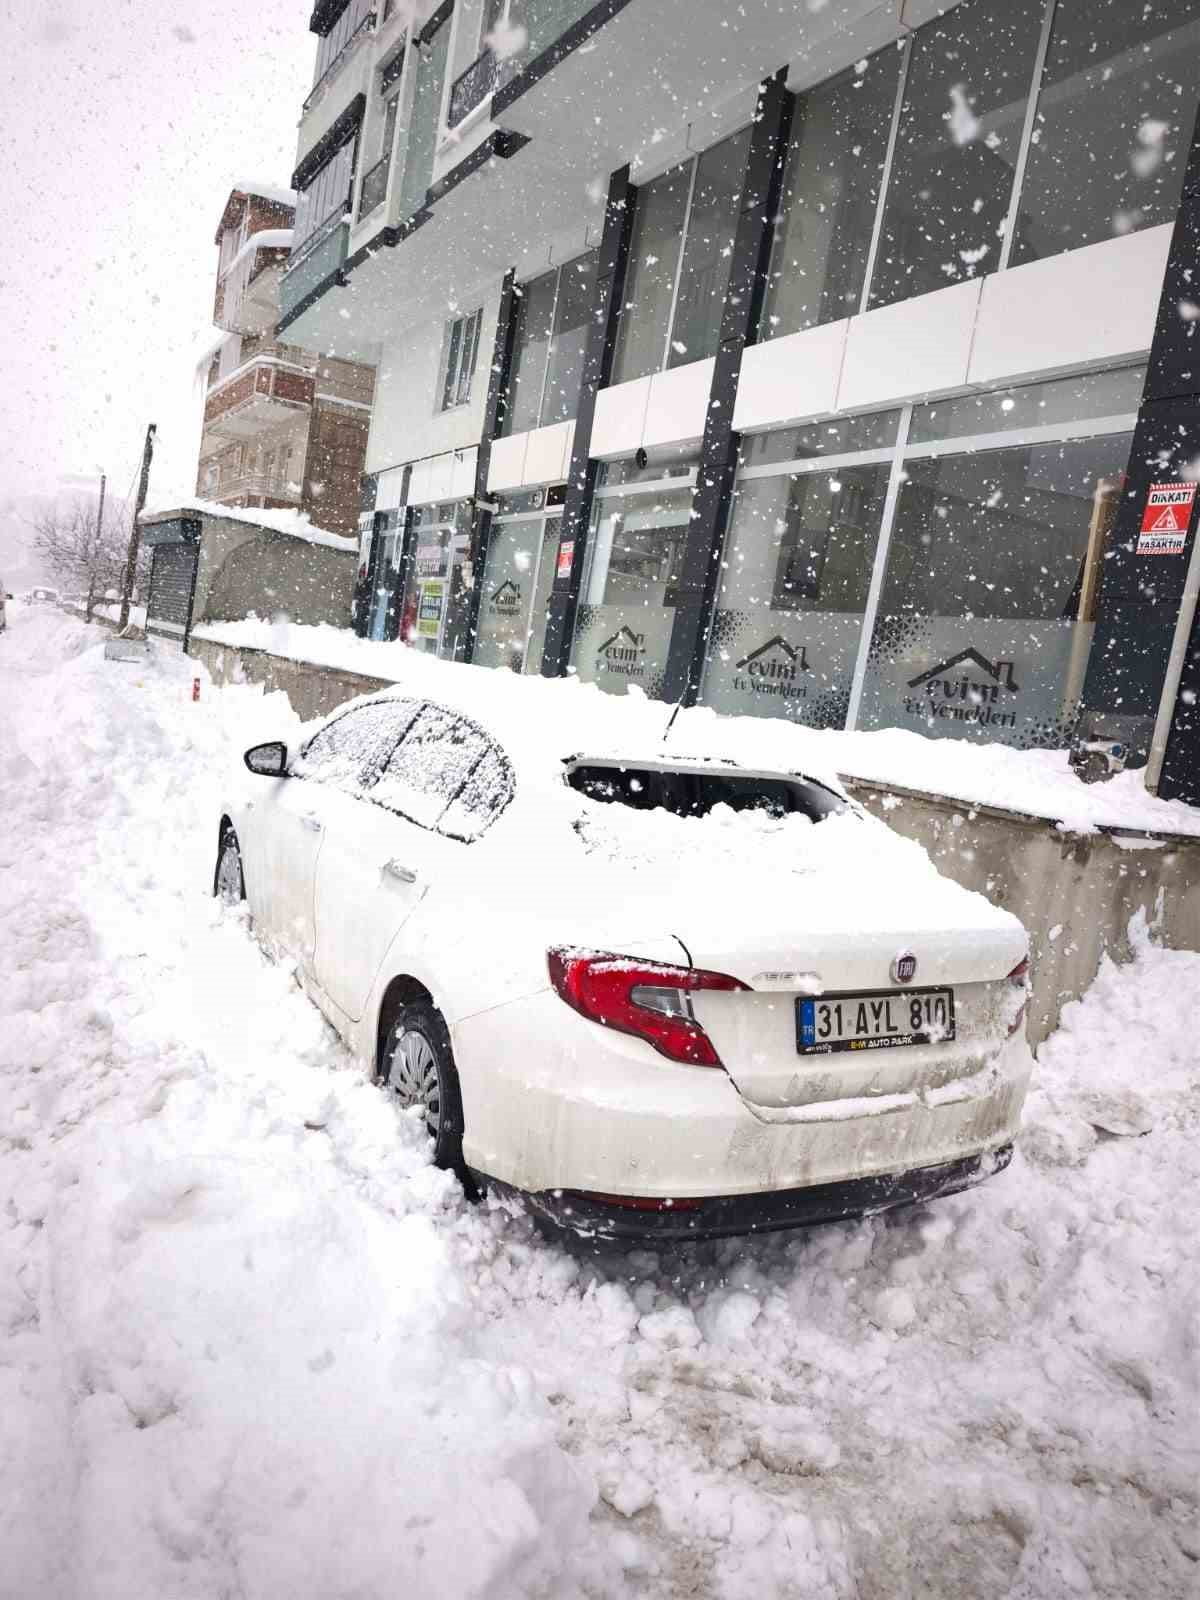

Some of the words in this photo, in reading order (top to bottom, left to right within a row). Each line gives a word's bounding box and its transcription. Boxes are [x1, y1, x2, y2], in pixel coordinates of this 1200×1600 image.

[748, 659, 797, 681] evim
[926, 676, 999, 704] evim
[929, 701, 1017, 727] Yemekleri
[899, 961, 914, 977] FIAT
[817, 1003, 843, 1038] 31
[855, 999, 899, 1035] AYL
[909, 997, 947, 1031] 810
[802, 1025, 815, 1037] TR
[867, 1039, 890, 1049] AUTO
[891, 1035, 913, 1046] PARK
